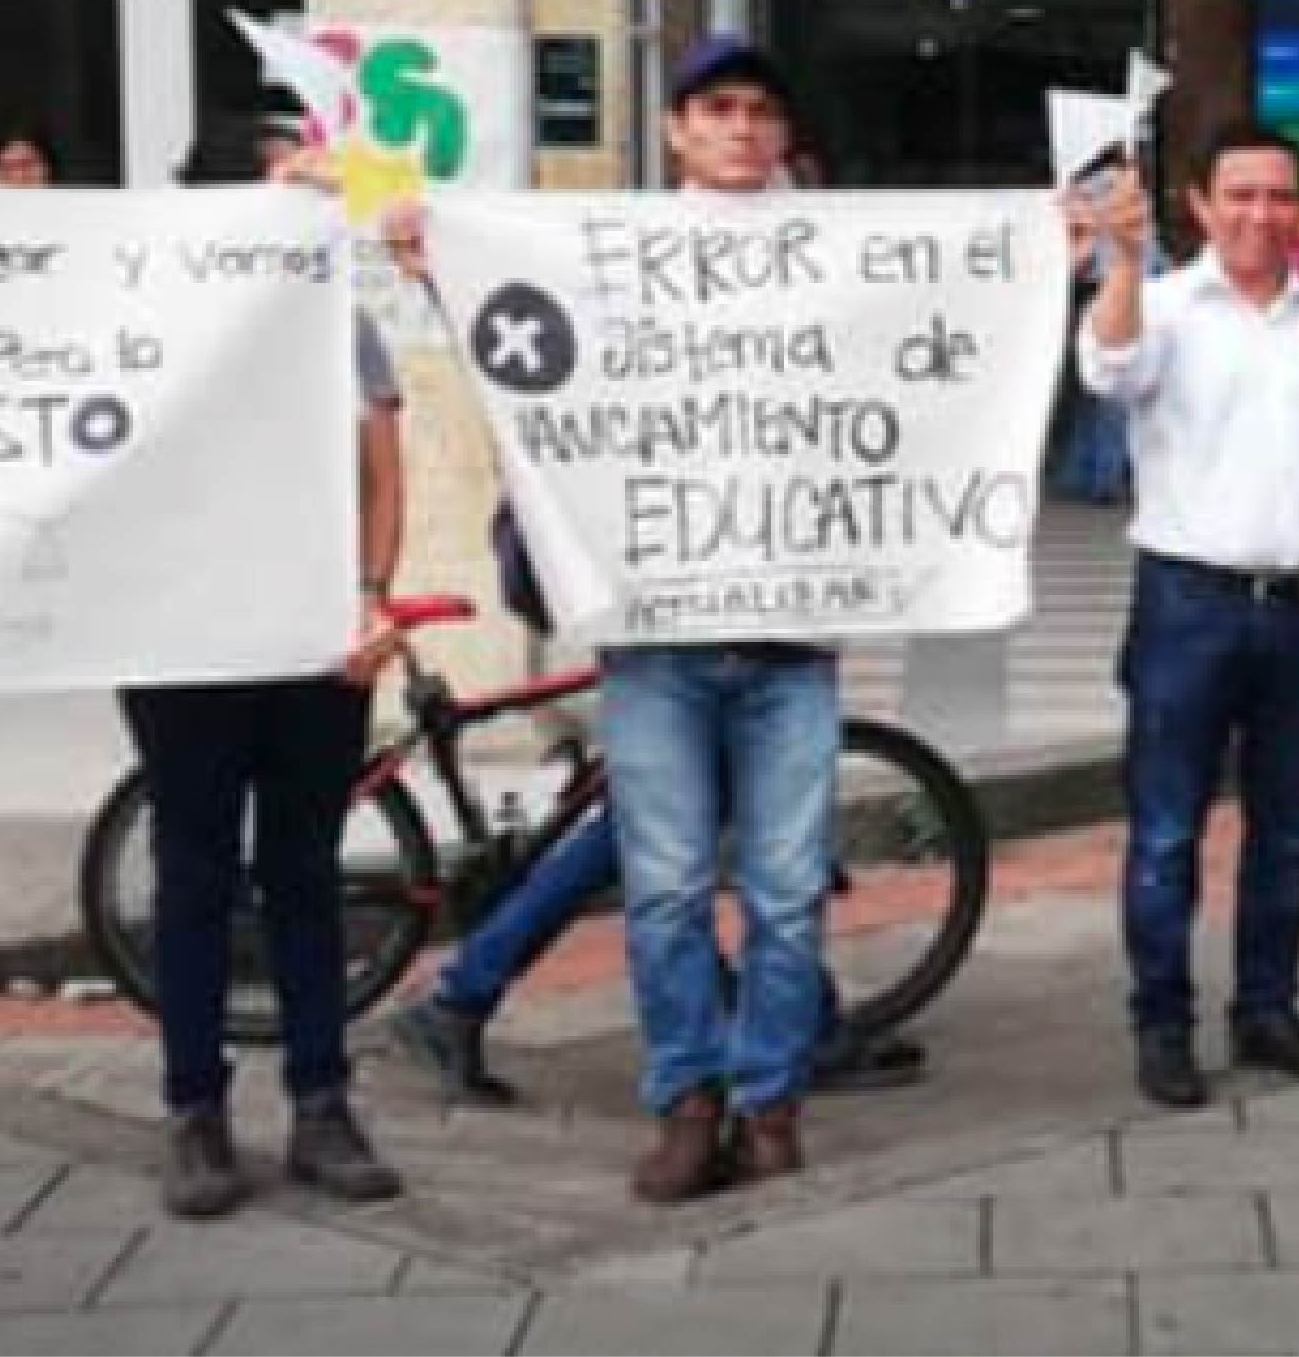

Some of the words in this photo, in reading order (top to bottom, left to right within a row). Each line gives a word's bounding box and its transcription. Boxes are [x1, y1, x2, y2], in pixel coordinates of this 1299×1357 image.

[581, 216, 822, 303] ERROR
[856, 232, 941, 282] en
[896, 309, 980, 383] de
[624, 470, 1030, 566] EDUCATIVO
